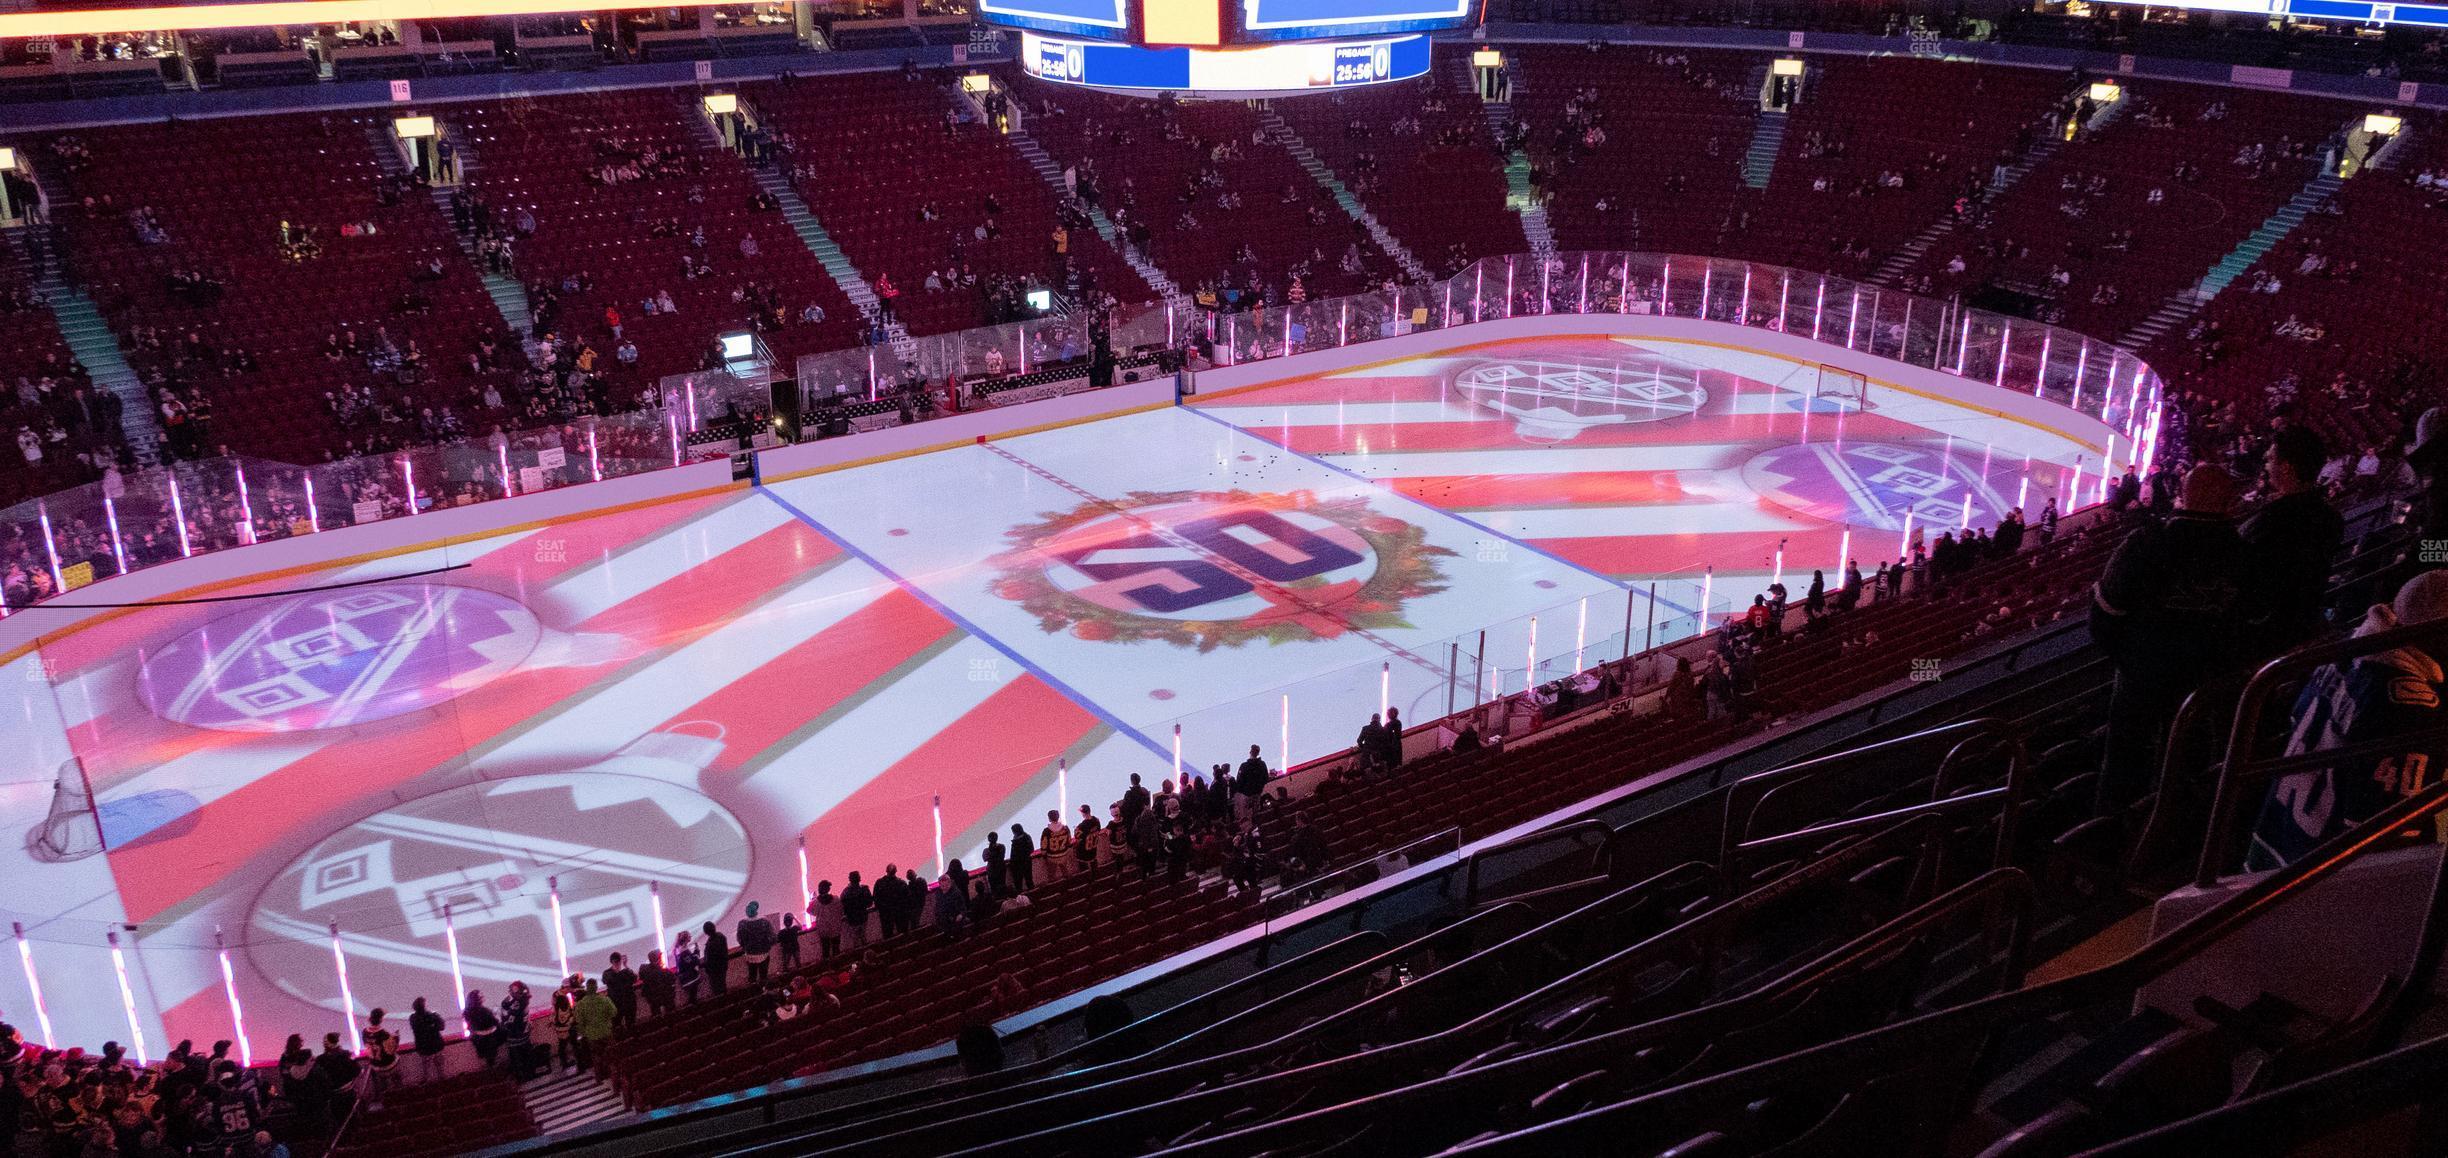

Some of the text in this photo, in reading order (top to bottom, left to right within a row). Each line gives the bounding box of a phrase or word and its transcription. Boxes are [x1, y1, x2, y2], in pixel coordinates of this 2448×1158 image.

[1067, 49, 1081, 78] 0
[1375, 47, 1388, 77] 0
[393, 83, 407, 93] 116
[1050, 508, 1364, 612] 50
[2373, 753, 2429, 796] 40
[222, 1109, 250, 1132] 96
